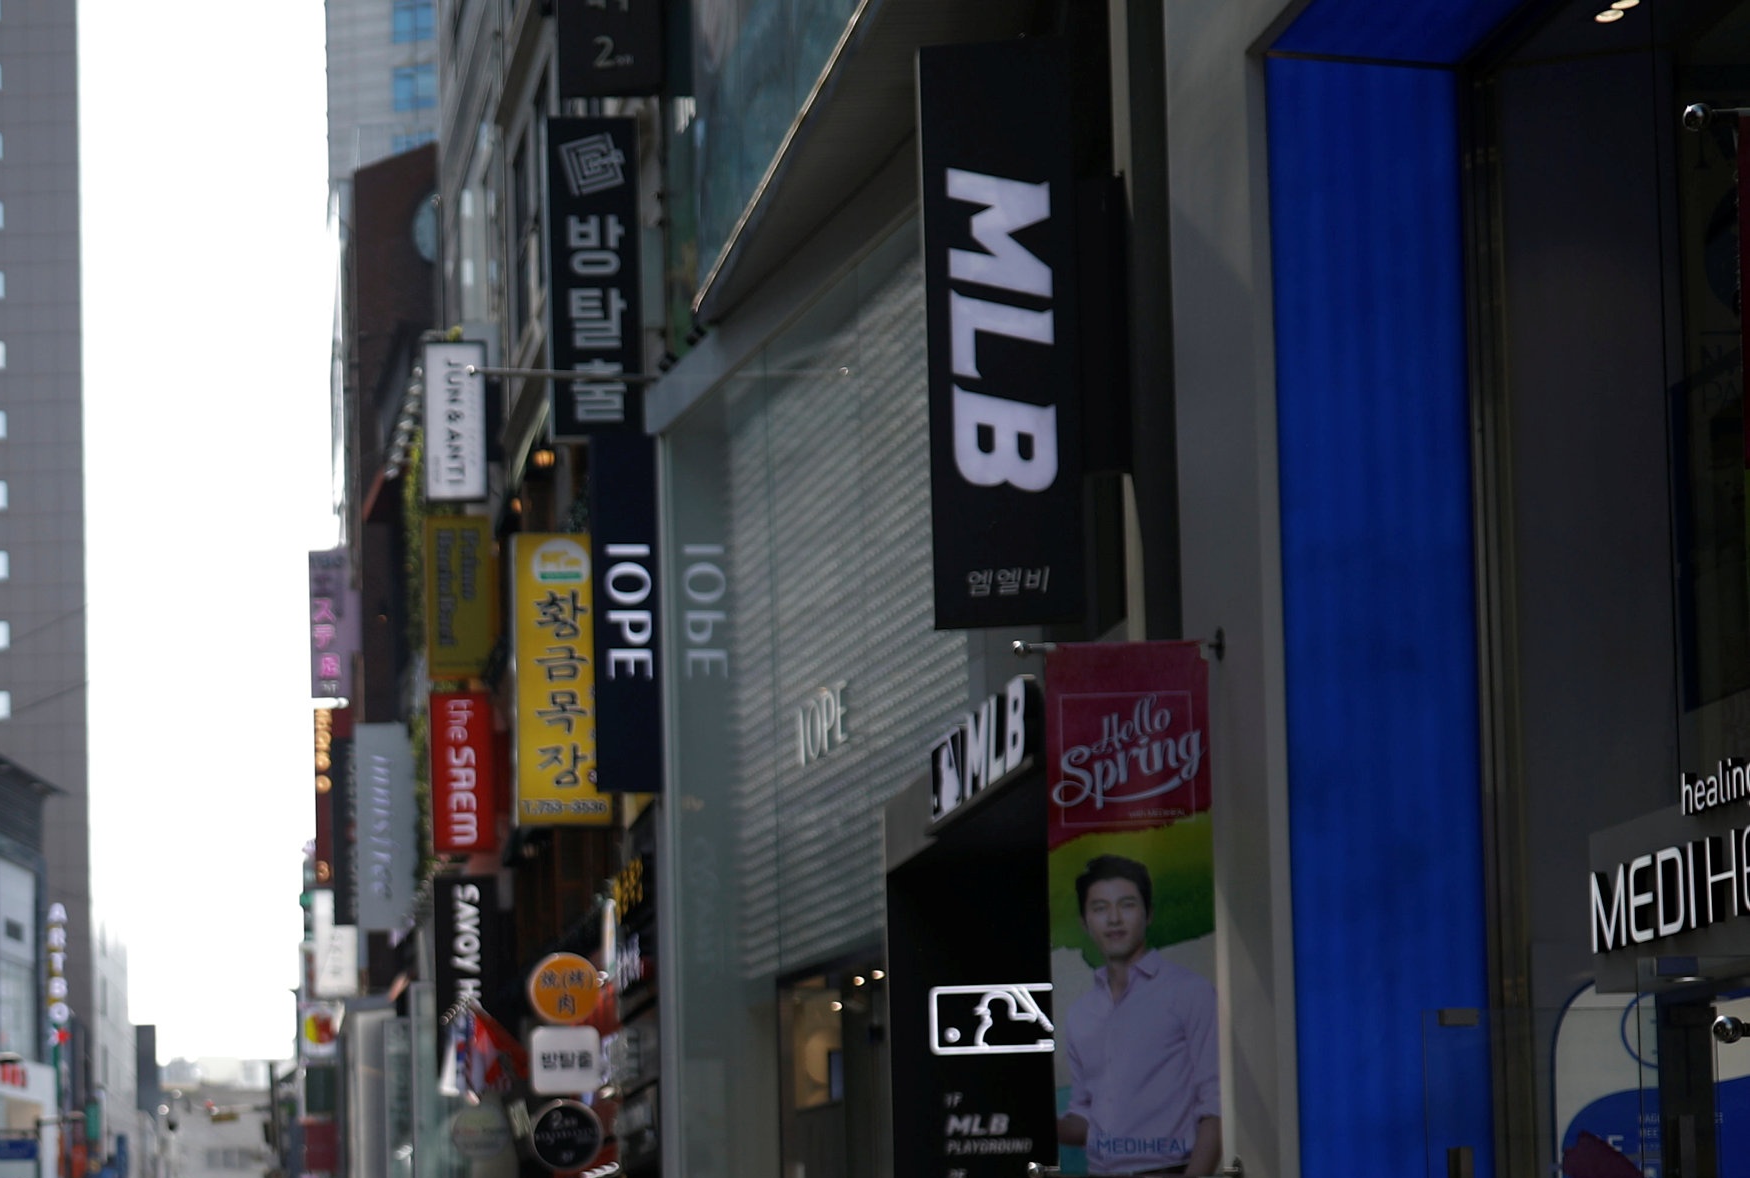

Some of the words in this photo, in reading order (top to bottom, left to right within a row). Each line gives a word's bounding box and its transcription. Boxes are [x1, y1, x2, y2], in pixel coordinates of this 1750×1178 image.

[565, 214, 627, 424] 방탈출
[945, 167, 1059, 493] MLB
[446, 356, 462, 403] JUN
[447, 409, 463, 422] &
[446, 429, 466, 485] ANTI
[602, 543, 654, 681] IOPE
[967, 565, 1051, 597] 엠엘비
[446, 699, 474, 743] the
[534, 588, 590, 789] 황금목장
[797, 680, 849, 767] IOPE
[1091, 694, 1171, 754] Hello
[963, 674, 1028, 799] MLB
[1052, 729, 1207, 811] Spring
[368, 754, 394, 900] innisfree
[447, 745, 479, 847] SAEM
[451, 883, 481, 975] SAVOY
[946, 1112, 1010, 1136] MLB
[946, 1137, 1034, 1155] PLAYGROUND
[1097, 1137, 1188, 1154] MEDIHEAL
